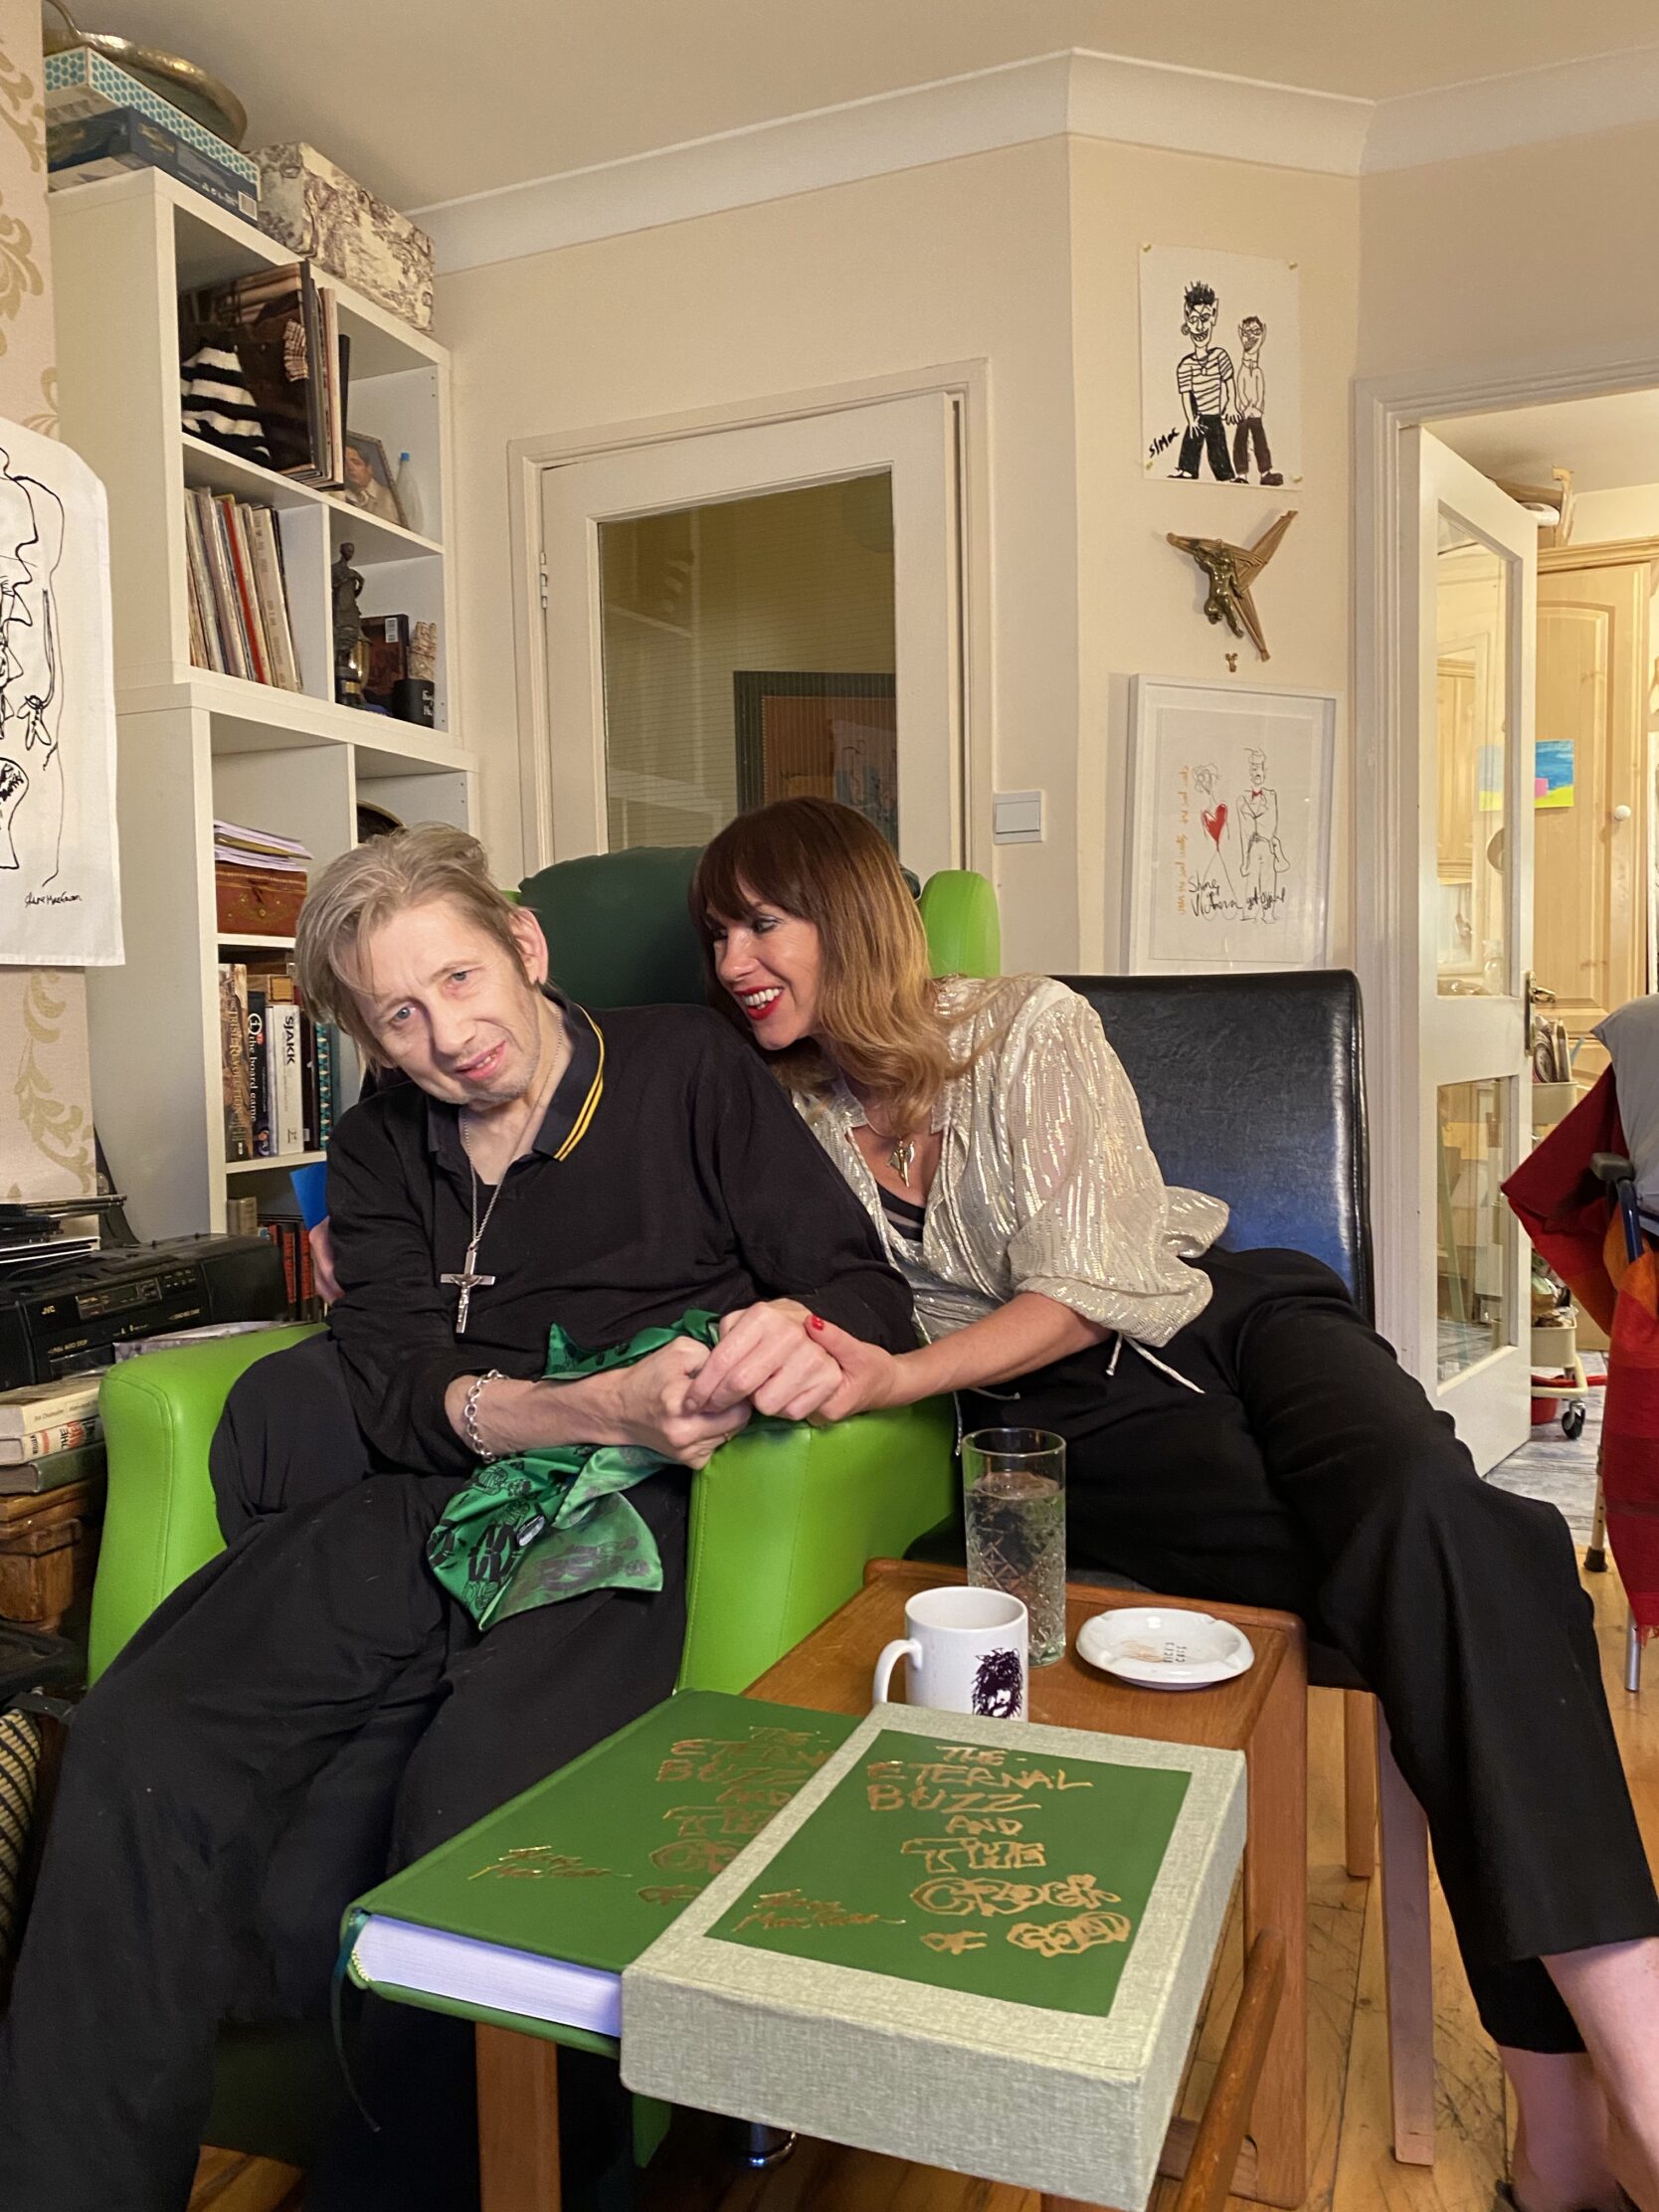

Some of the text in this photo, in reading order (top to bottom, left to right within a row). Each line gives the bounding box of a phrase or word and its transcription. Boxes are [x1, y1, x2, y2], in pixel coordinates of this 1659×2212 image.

[282, 1014, 296, 1065] SJAKK
[250, 1056, 259, 1089] board
[42, 1305, 56, 1315] JVC
[670, 1739, 834, 1766] ETERN
[935, 1746, 1009, 1766] THE
[867, 1759, 1094, 1790] ETERNAL
[866, 1784, 1042, 1813] BUZZ
[945, 1815, 1023, 1836] AND
[900, 1837, 1046, 1874] THE
